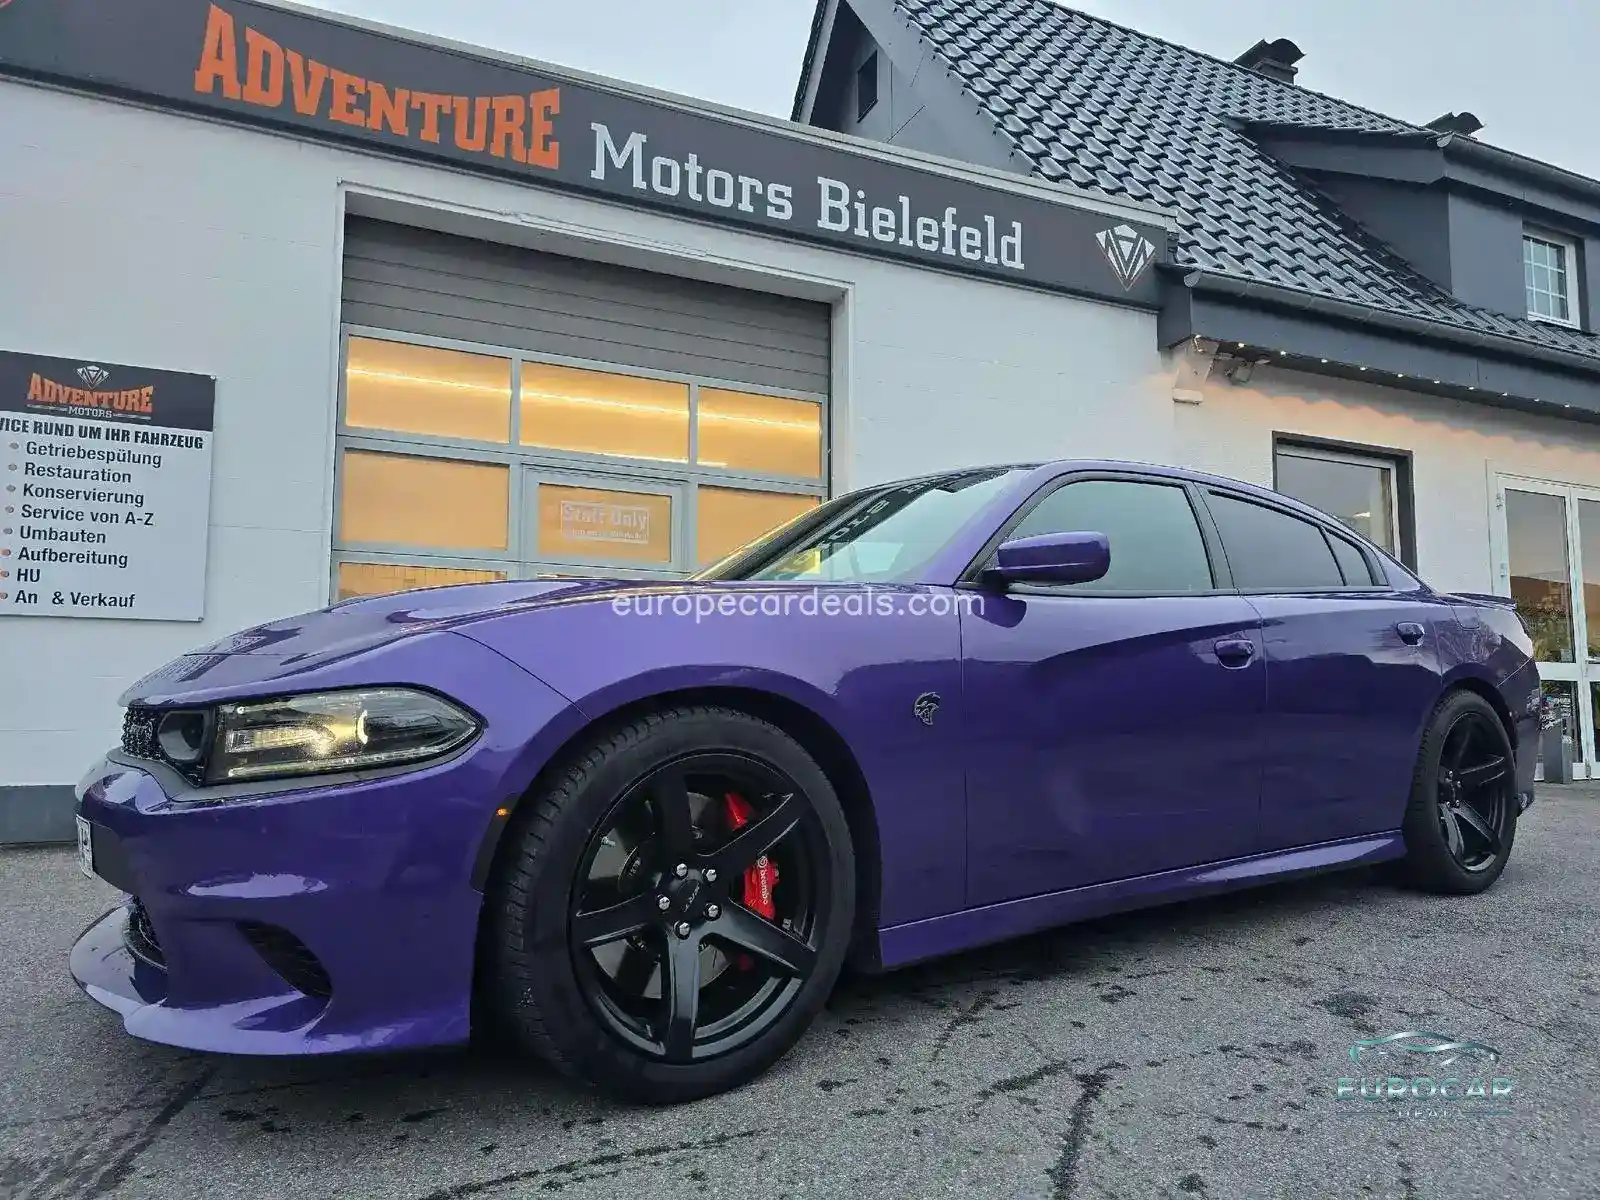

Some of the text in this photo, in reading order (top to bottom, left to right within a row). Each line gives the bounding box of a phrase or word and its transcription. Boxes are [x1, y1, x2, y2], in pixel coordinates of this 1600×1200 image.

[194, 3, 1026, 271] ADVENTURE Motors Bielefeld
[27, 372, 154, 413] ADVENTURE
[68, 406, 112, 418] MOTORS
[33, 420, 74, 437] RUND
[79, 425, 102, 440] UM
[105, 428, 130, 442] IHR
[134, 430, 204, 449] FAHRZEUG
[26, 441, 162, 469] Getriebespülung
[24, 461, 132, 483] Restauration
[23, 483, 144, 507] Konservierung
[21, 503, 154, 526] Service von A-Z
[20, 525, 106, 544] Umbauten
[17, 546, 128, 569] Aufbereitung
[16, 568, 41, 583] HU
[15, 589, 136, 608] An & Verkauf
